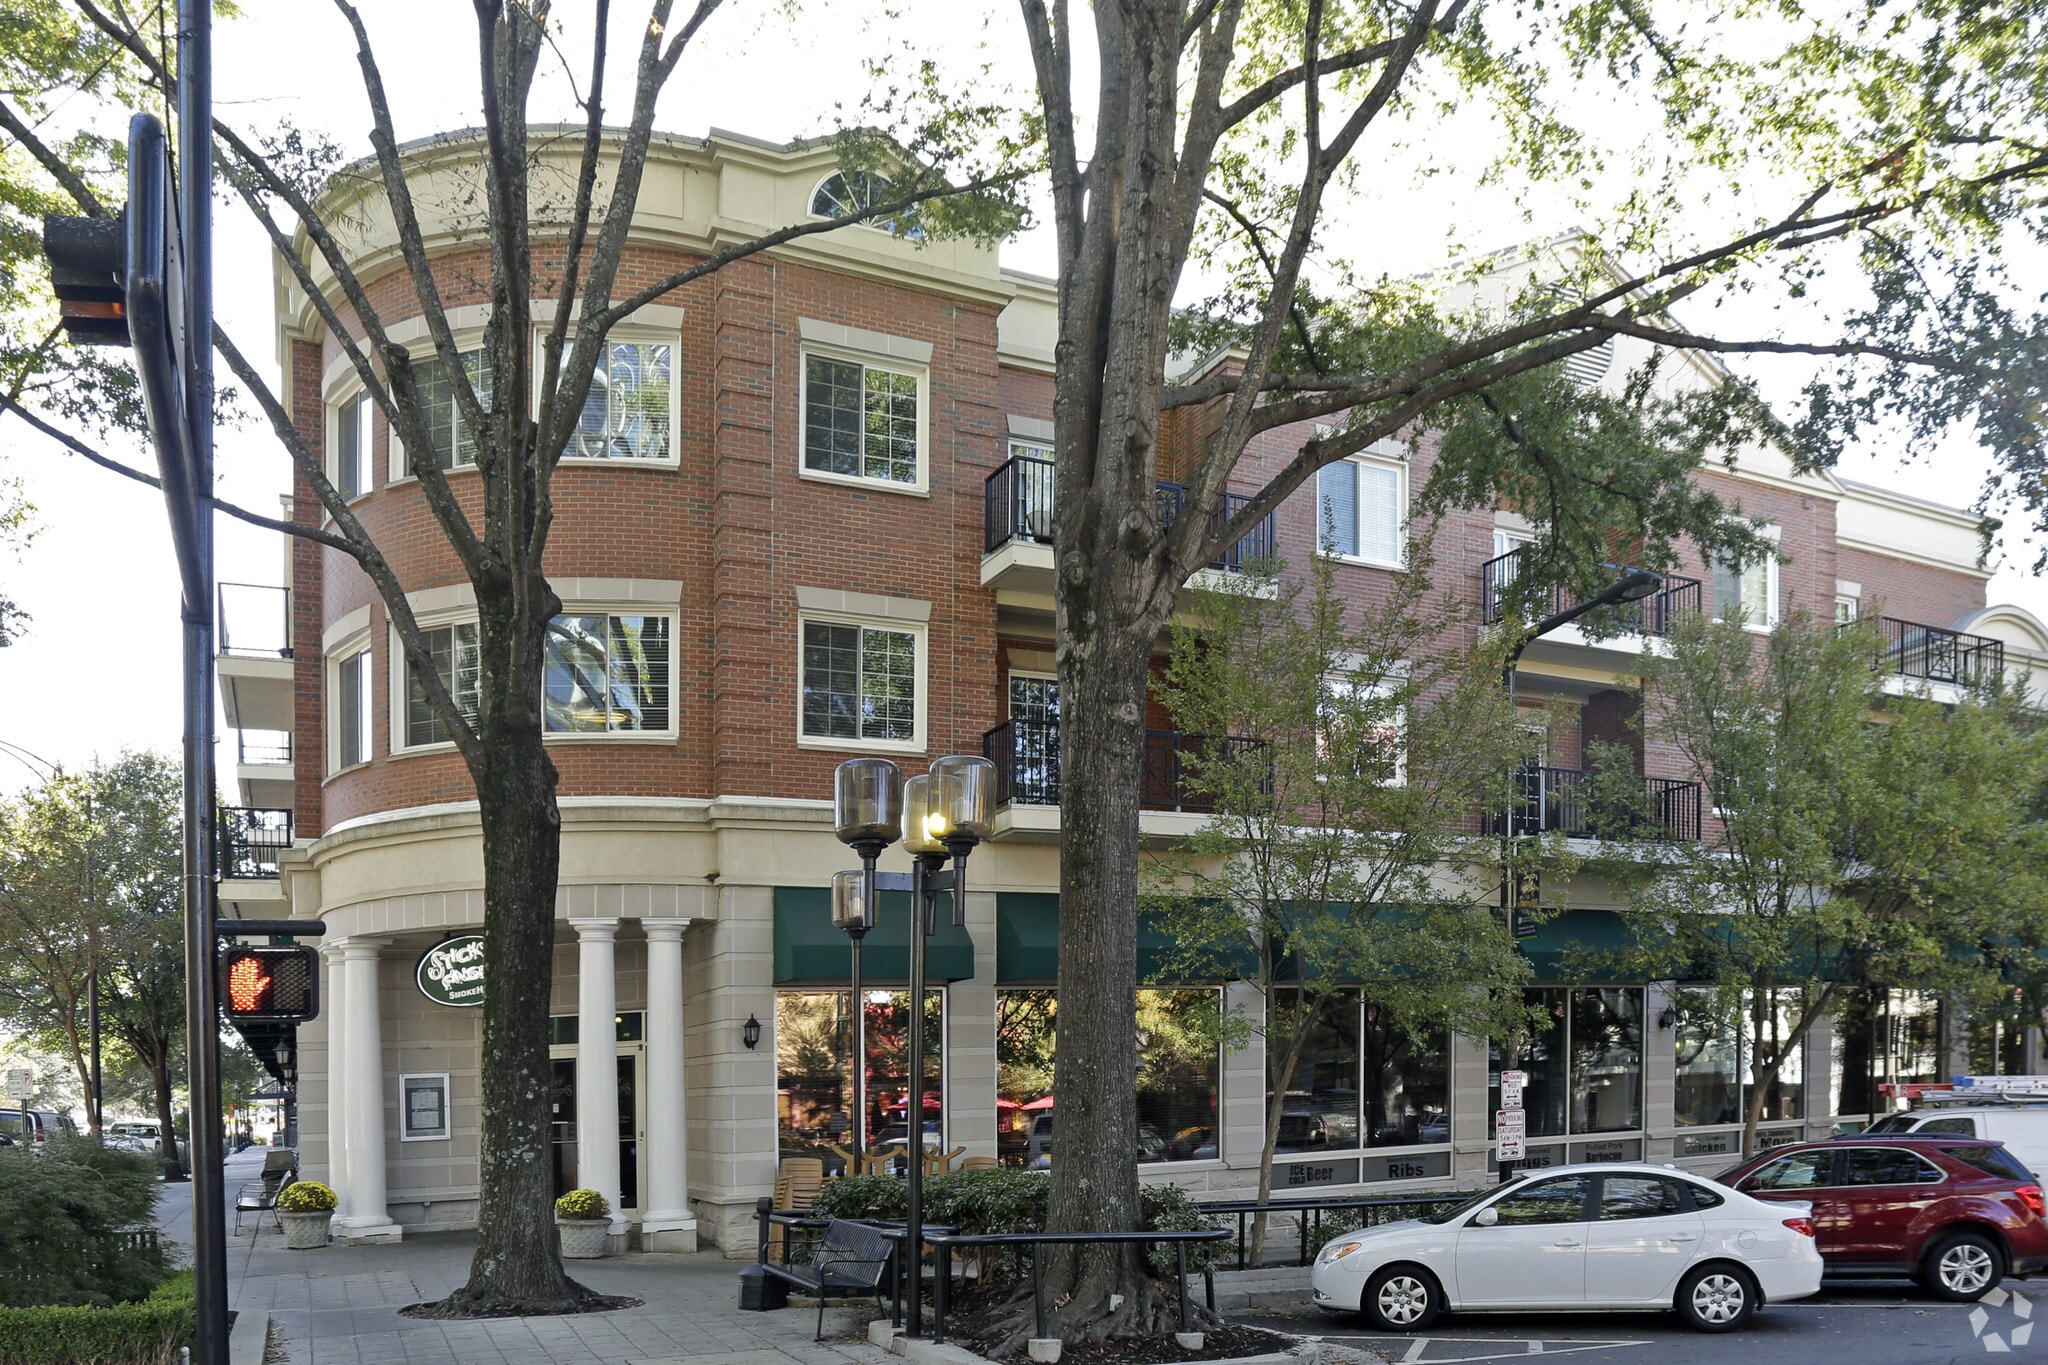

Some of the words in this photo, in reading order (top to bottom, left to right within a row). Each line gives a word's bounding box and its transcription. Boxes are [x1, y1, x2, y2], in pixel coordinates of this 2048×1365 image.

[428, 942, 484, 980] STICK
[449, 985, 483, 999] SMOKEH
[1608, 1142, 1623, 1150] Pork
[1685, 1143, 1726, 1154] Chicken
[1586, 1152, 1623, 1163] Barbecue
[1290, 1164, 1305, 1176] ICE
[1307, 1166, 1333, 1182] Beer
[1389, 1163, 1425, 1178] Ribs
[1289, 1176, 1306, 1185] COLD
